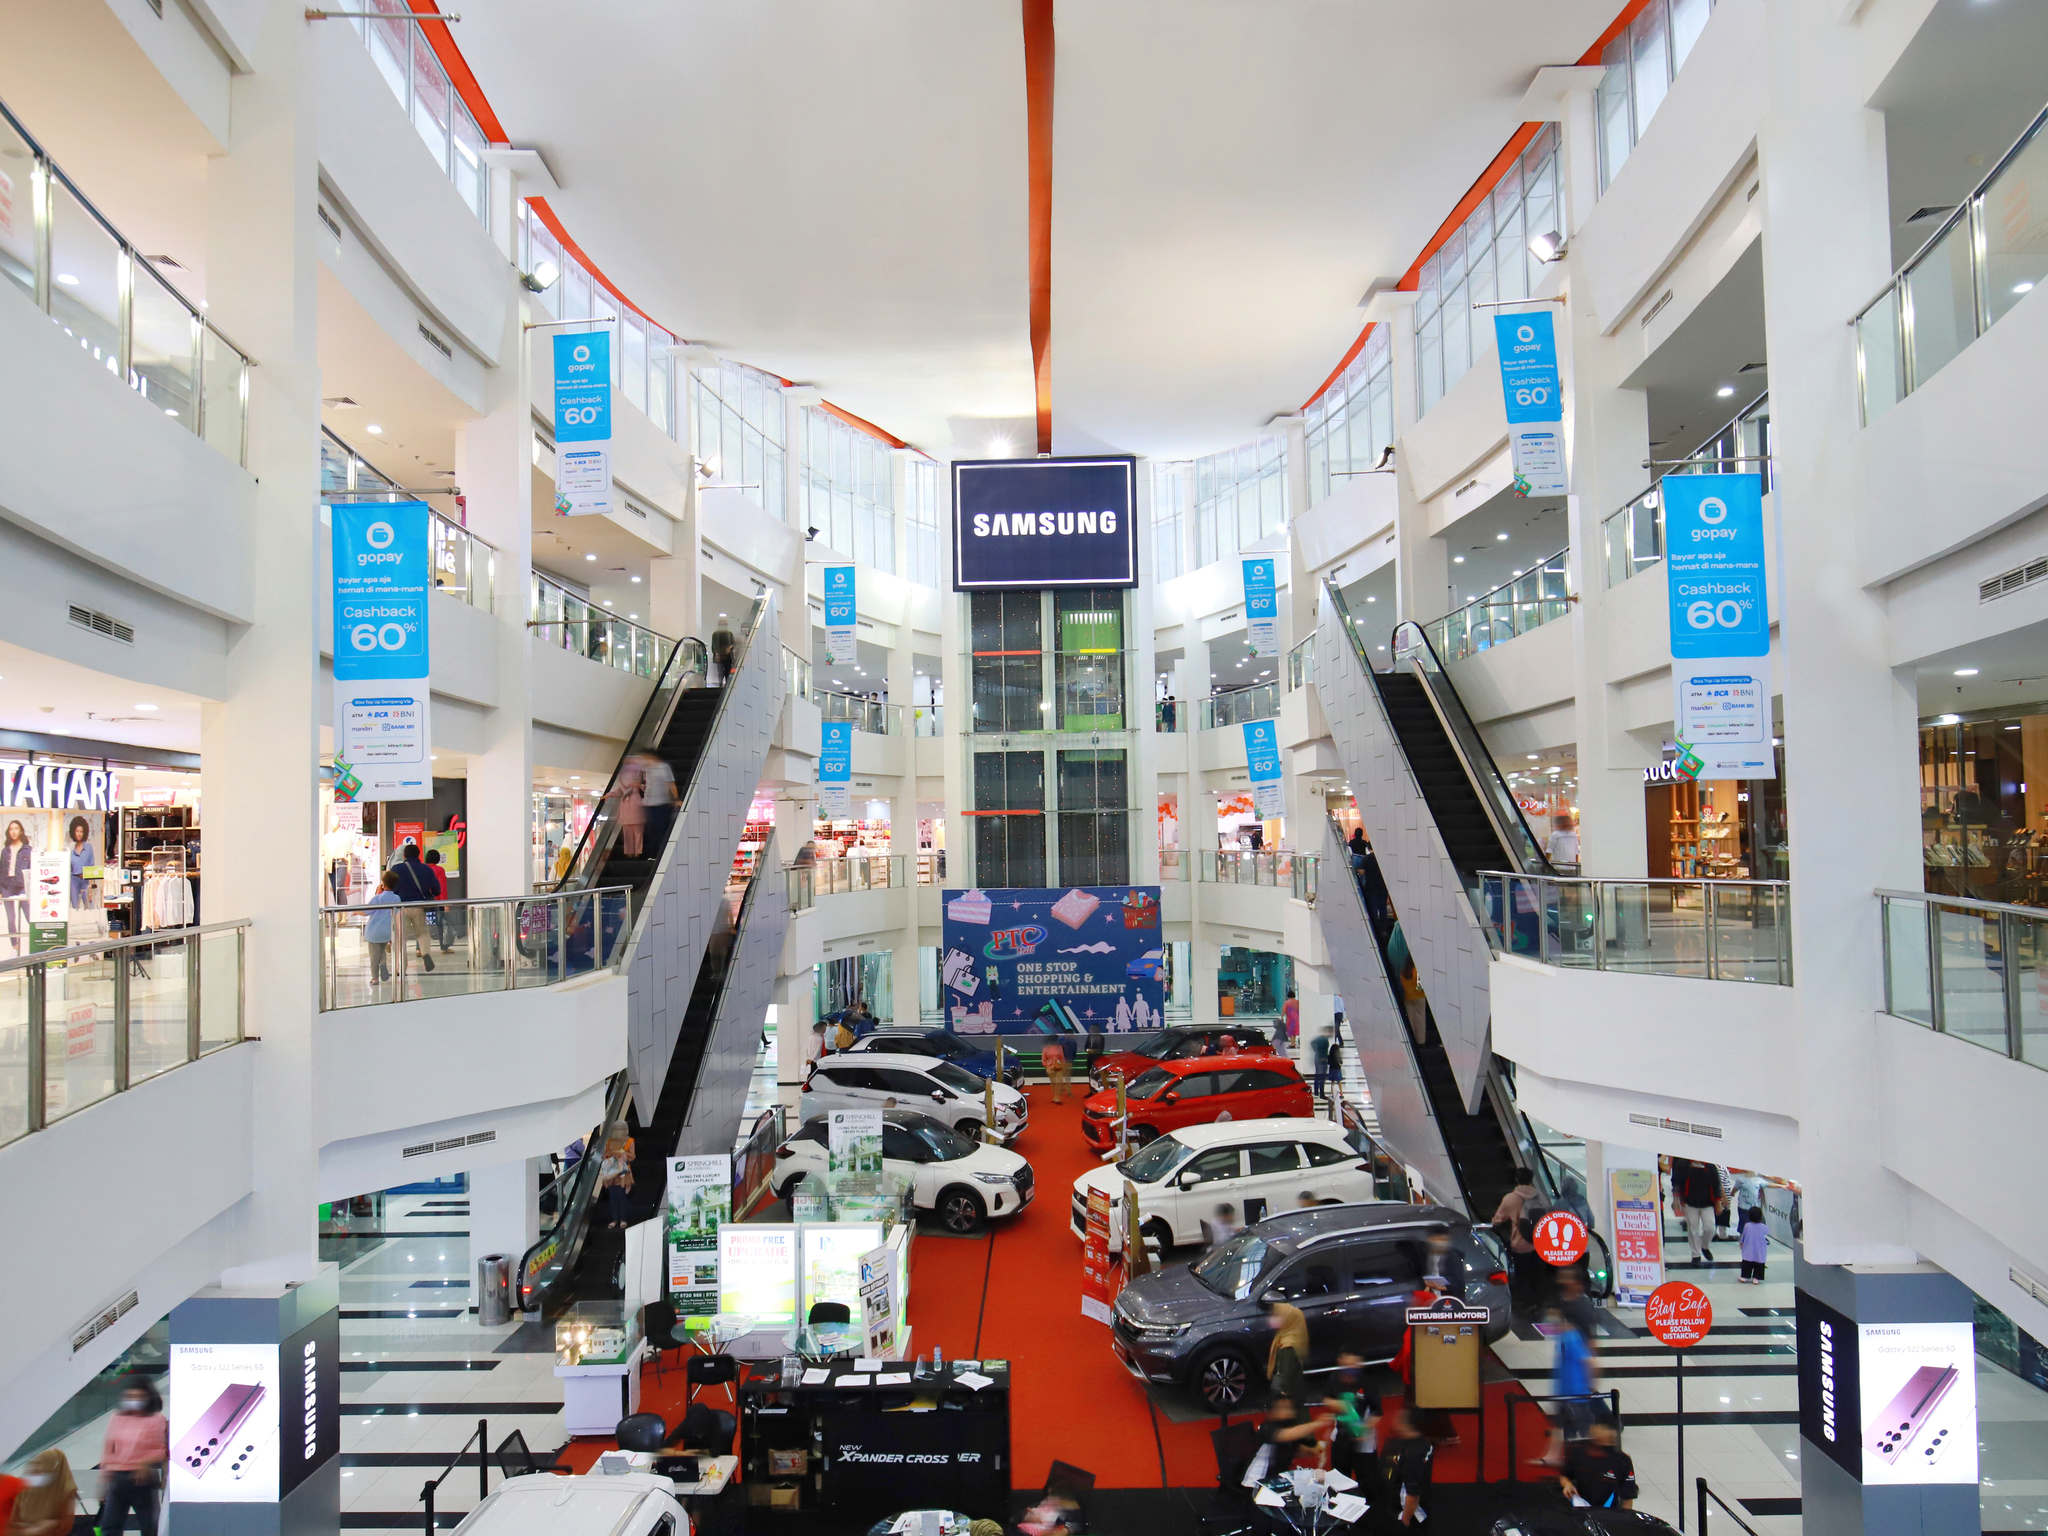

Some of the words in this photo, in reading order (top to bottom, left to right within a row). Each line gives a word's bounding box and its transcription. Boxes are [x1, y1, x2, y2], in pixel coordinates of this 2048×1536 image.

[1514, 343, 1541, 353] gopay
[568, 363, 595, 373] gopay
[1509, 376, 1552, 386] Cashback
[560, 395, 602, 405] Cashback
[973, 510, 1117, 537] SAMSUNG
[1691, 527, 1737, 542] gopay
[357, 551, 404, 566] gopay
[1678, 582, 1751, 595] Cashback
[343, 605, 416, 618] Cashback
[992, 927, 1037, 950] PTC
[1017, 963, 1043, 973] ONE
[1046, 962, 1078, 972] STOP
[1017, 973, 1082, 984] SHOPPING
[1084, 973, 1094, 983] &
[1017, 984, 1127, 995] ENTERTAINMENT
[1621, 1212, 1651, 1221] Double
[1620, 1240, 1648, 1259] 3.5
[1648, 1295, 1676, 1321] Stay
[1679, 1288, 1708, 1317] Safe
[1409, 1312, 1453, 1320] MITSUBISHI
[1662, 1332, 1700, 1340] DISTANCING
[1820, 1320, 1836, 1443] SAMSUNG
[304, 1340, 316, 1460] SAMSUNG
[837, 1451, 903, 1463] XPANDER
[906, 1454, 949, 1464] CROSS
[957, 1453, 981, 1462] ER
